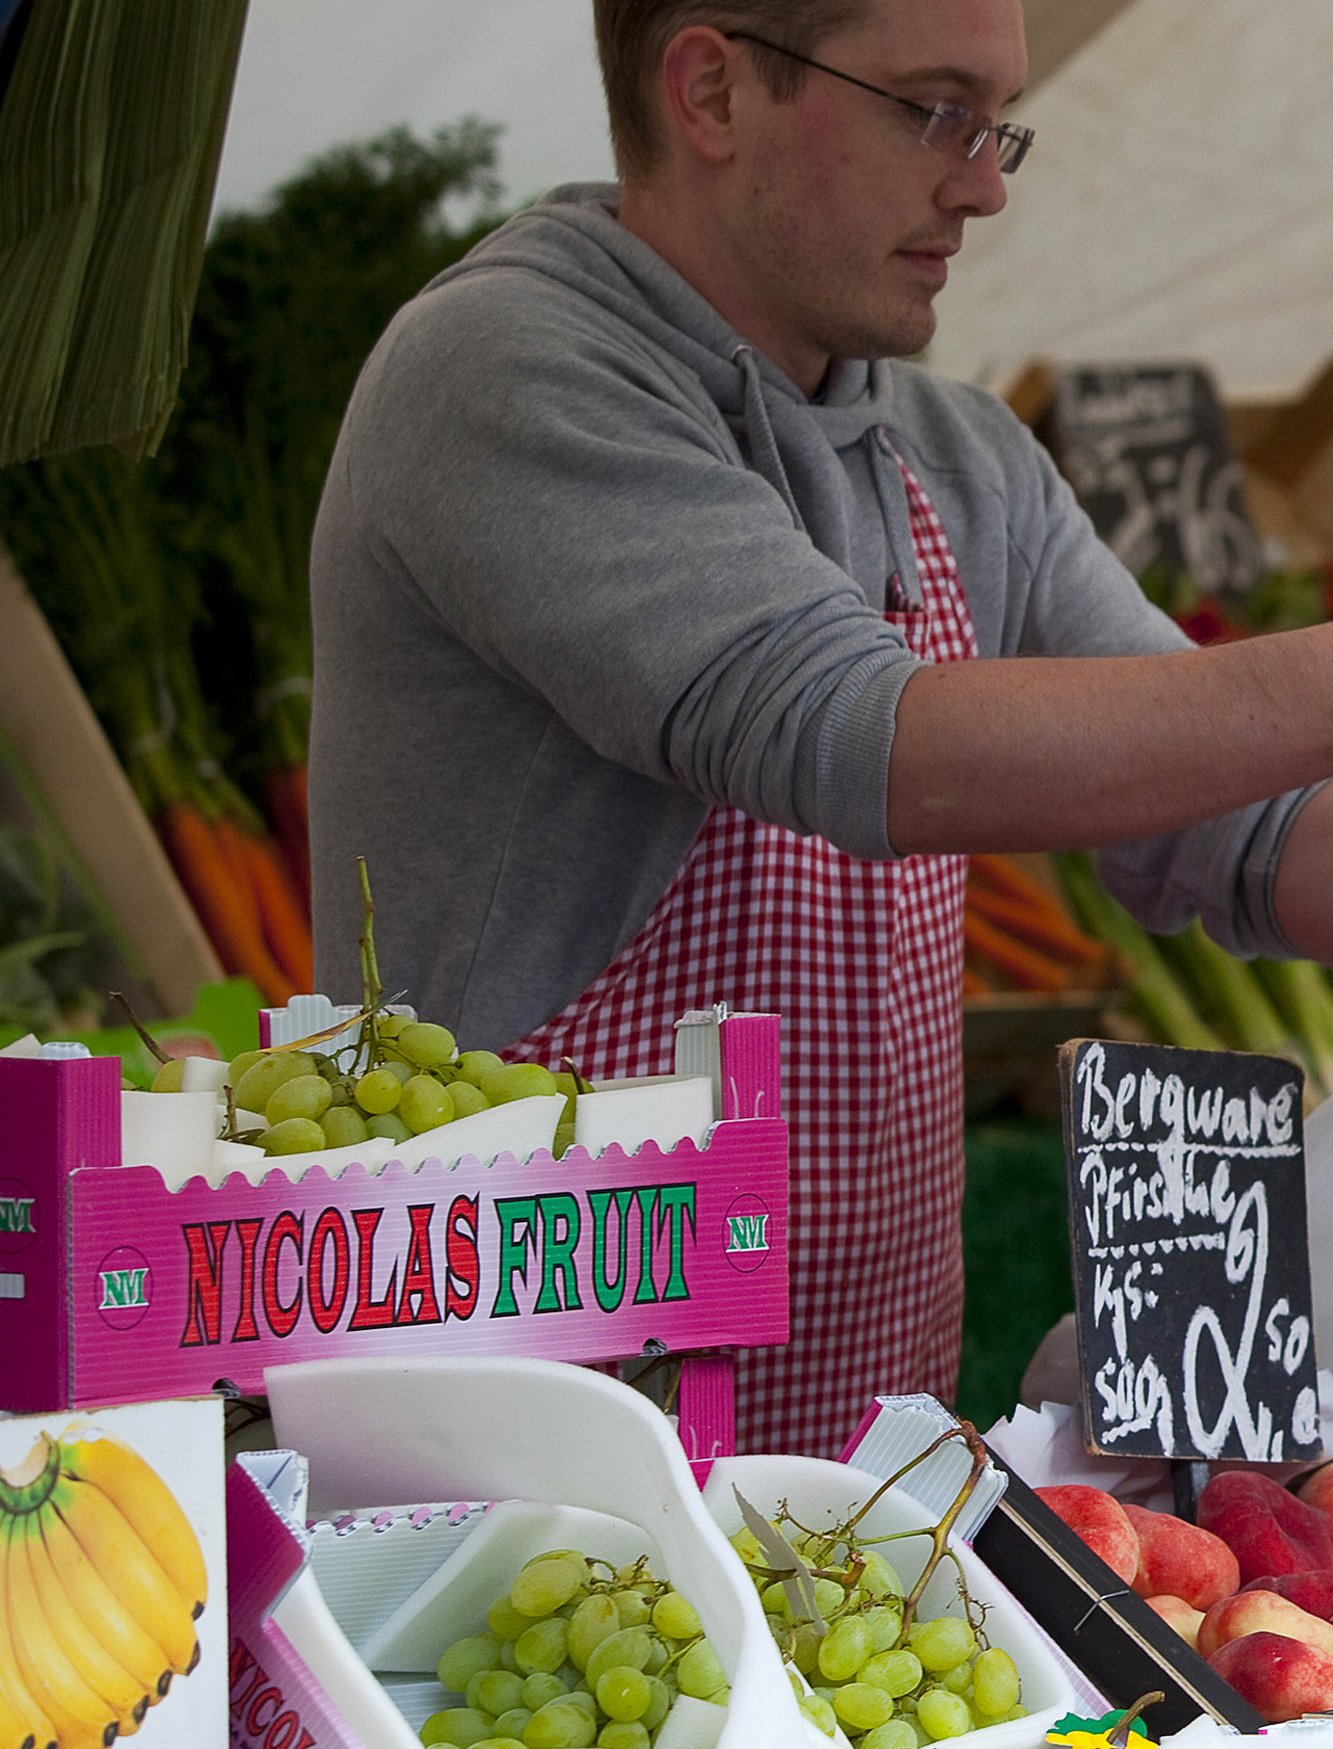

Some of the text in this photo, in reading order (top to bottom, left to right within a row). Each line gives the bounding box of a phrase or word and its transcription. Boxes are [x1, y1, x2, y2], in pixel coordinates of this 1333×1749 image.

[725, 1213, 770, 1254] NM
[179, 1181, 698, 1348] NICOLAS FRUIT
[98, 1267, 150, 1311] NM
